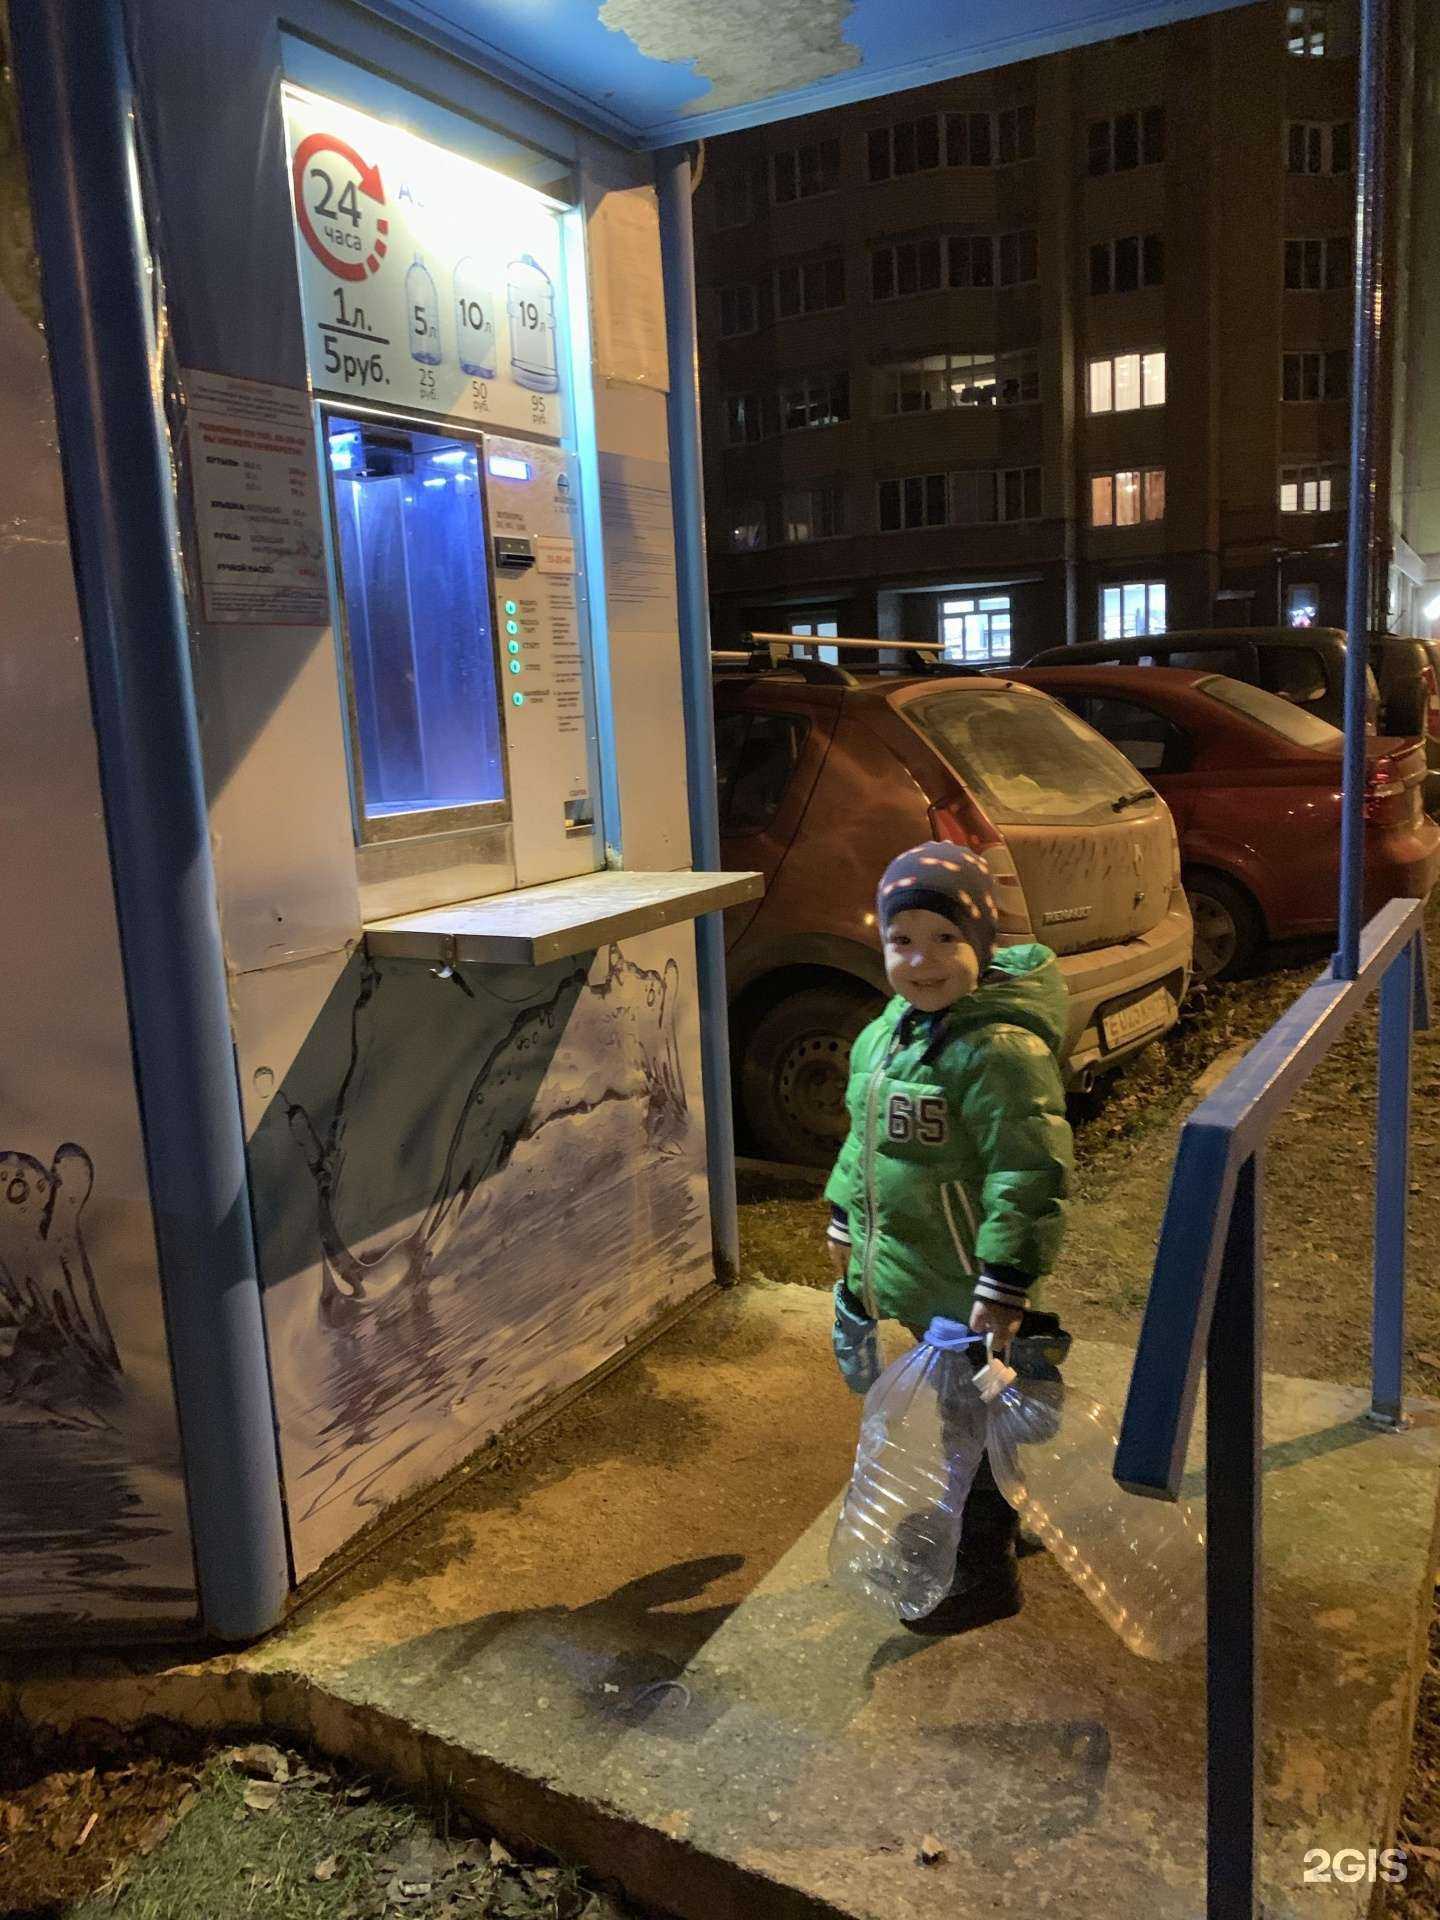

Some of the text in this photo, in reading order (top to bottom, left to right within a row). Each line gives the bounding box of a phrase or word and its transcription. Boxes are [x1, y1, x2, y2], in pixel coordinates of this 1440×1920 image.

[310, 168, 362, 228] 24
[325, 224, 362, 250] часа
[324, 335, 391, 386] 5руб.
[418, 368, 436, 388] 25
[471, 380, 489, 400] 50
[530, 395, 546, 413] 95
[1043, 906, 1093, 924] RENAULT
[888, 1092, 949, 1145] 65
